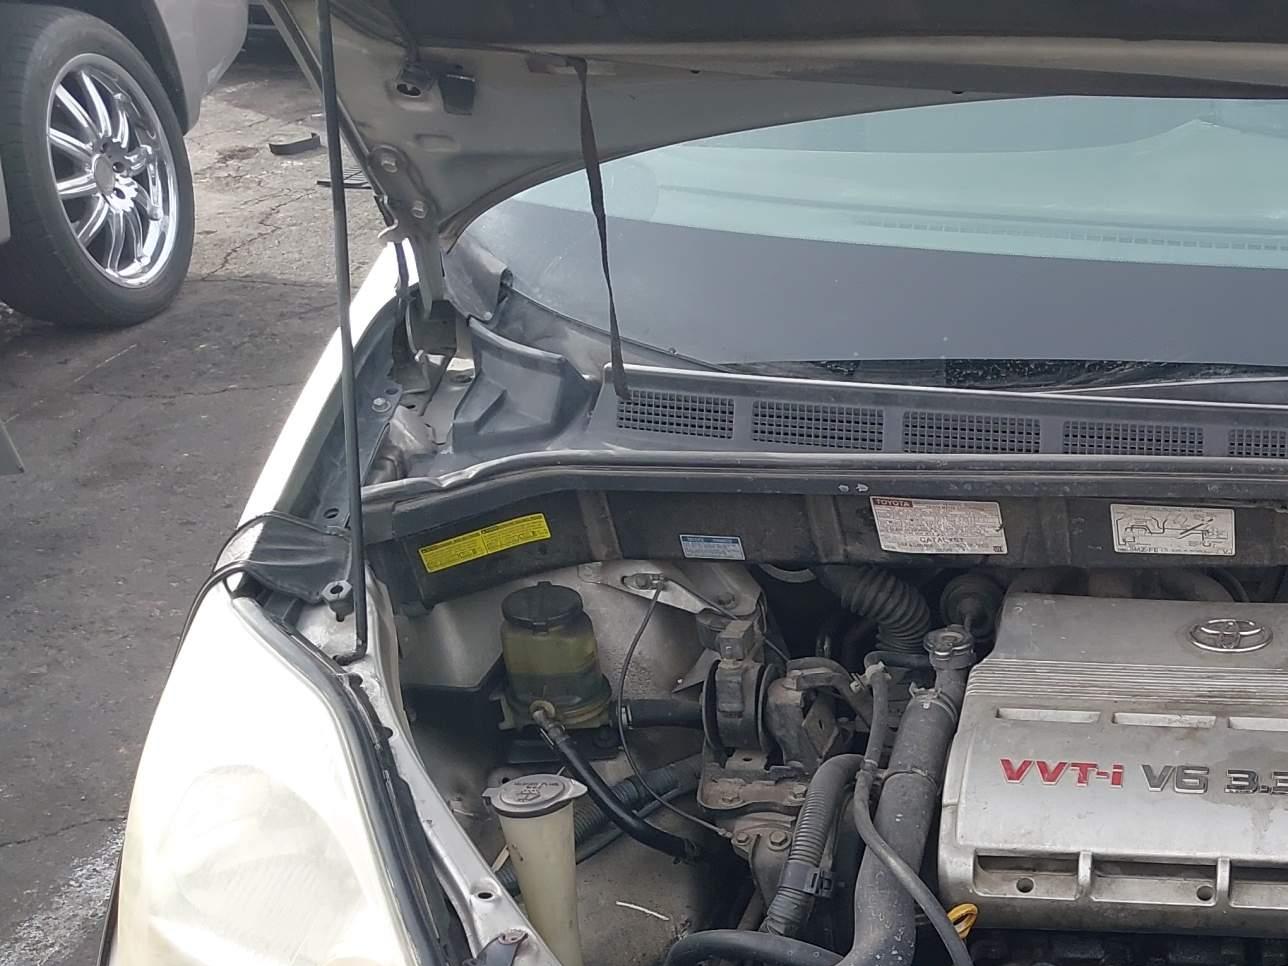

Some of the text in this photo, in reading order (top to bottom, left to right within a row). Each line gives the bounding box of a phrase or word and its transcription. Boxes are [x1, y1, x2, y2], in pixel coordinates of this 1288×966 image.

[876, 498, 911, 508] TOYOTA
[1000, 757, 1124, 789] VVT-i
[1141, 763, 1210, 794] V6
